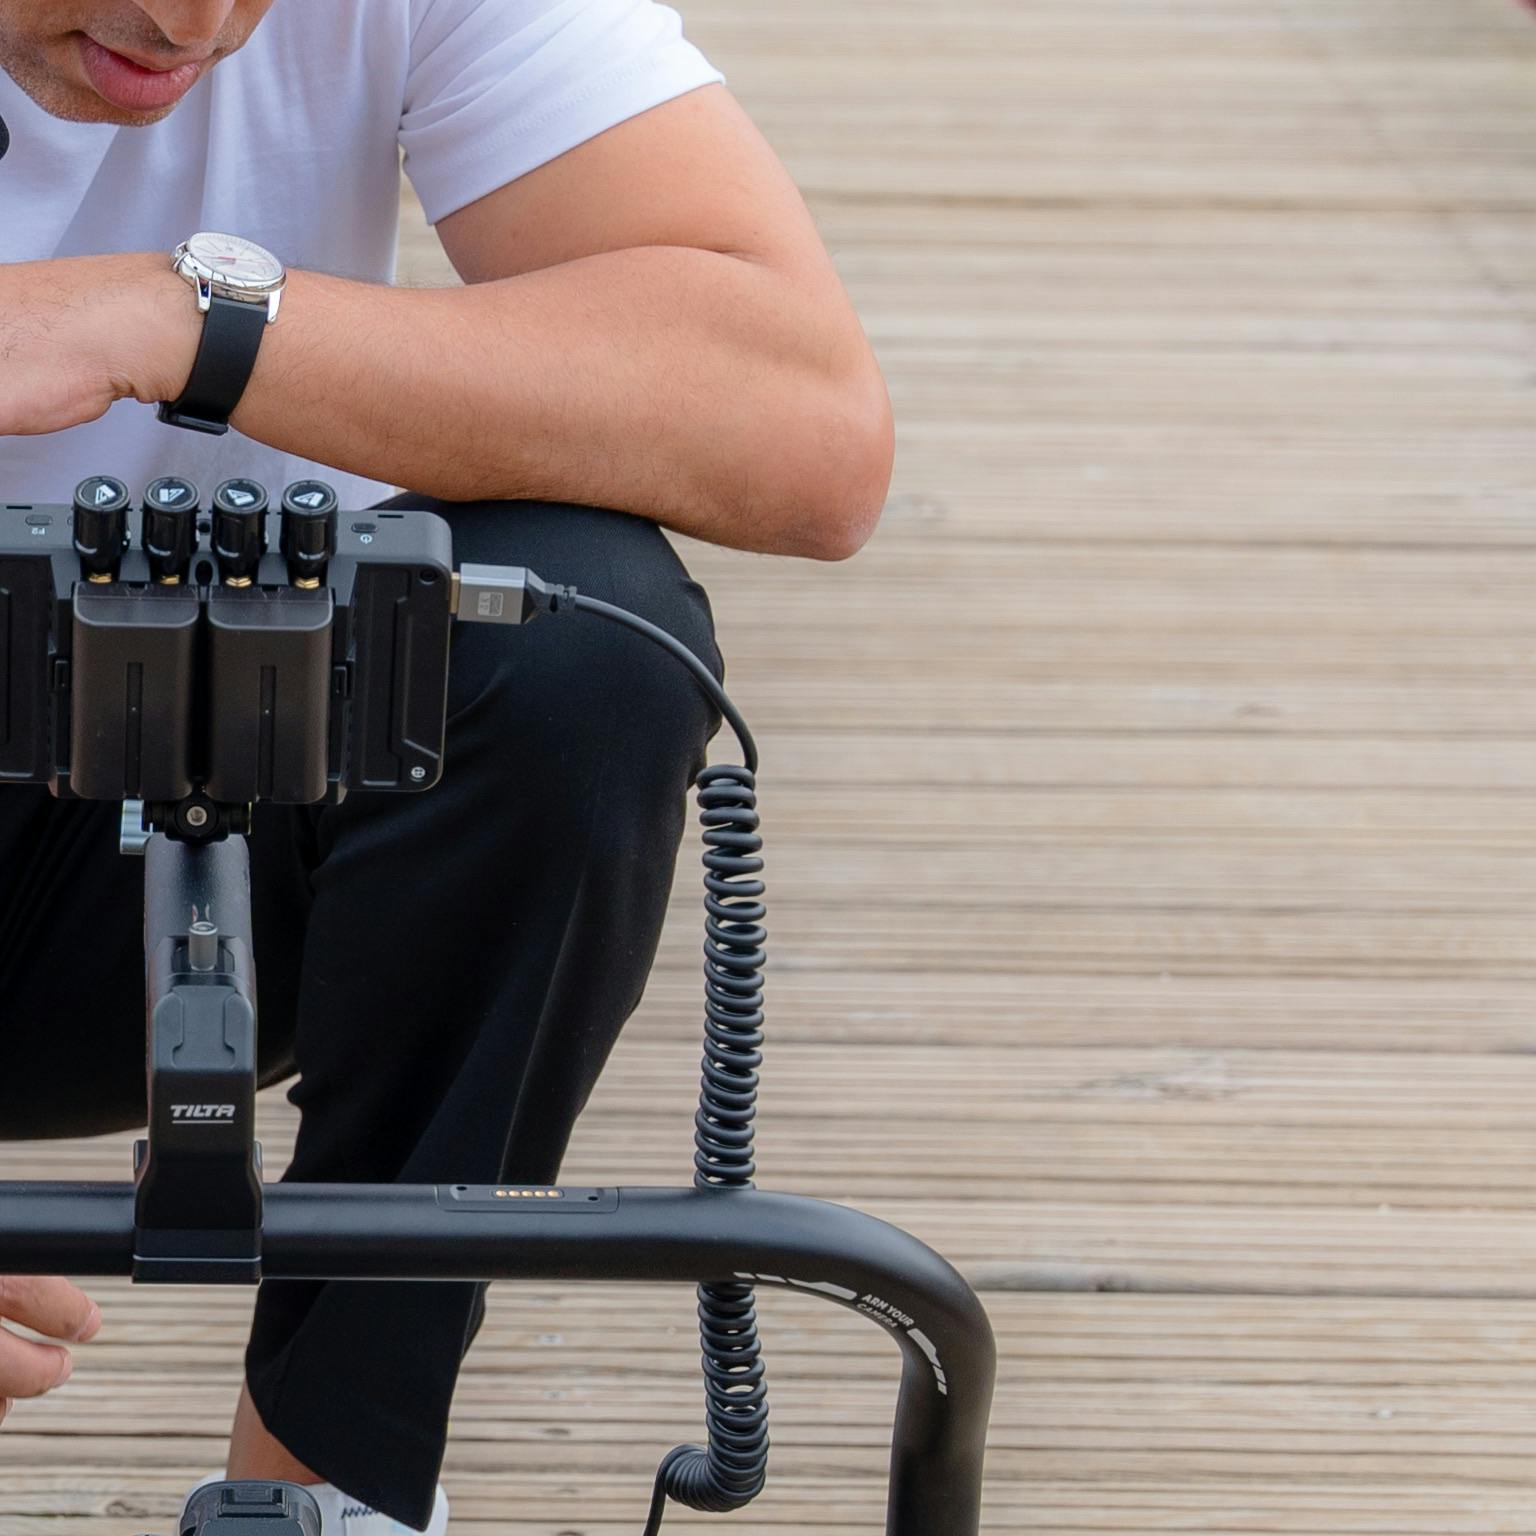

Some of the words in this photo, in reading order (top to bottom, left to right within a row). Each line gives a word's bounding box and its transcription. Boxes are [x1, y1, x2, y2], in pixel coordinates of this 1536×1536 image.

[170, 1104, 236, 1118] TILTA
[861, 1294, 889, 1310] ARM
[886, 1305, 915, 1327] YOUR
